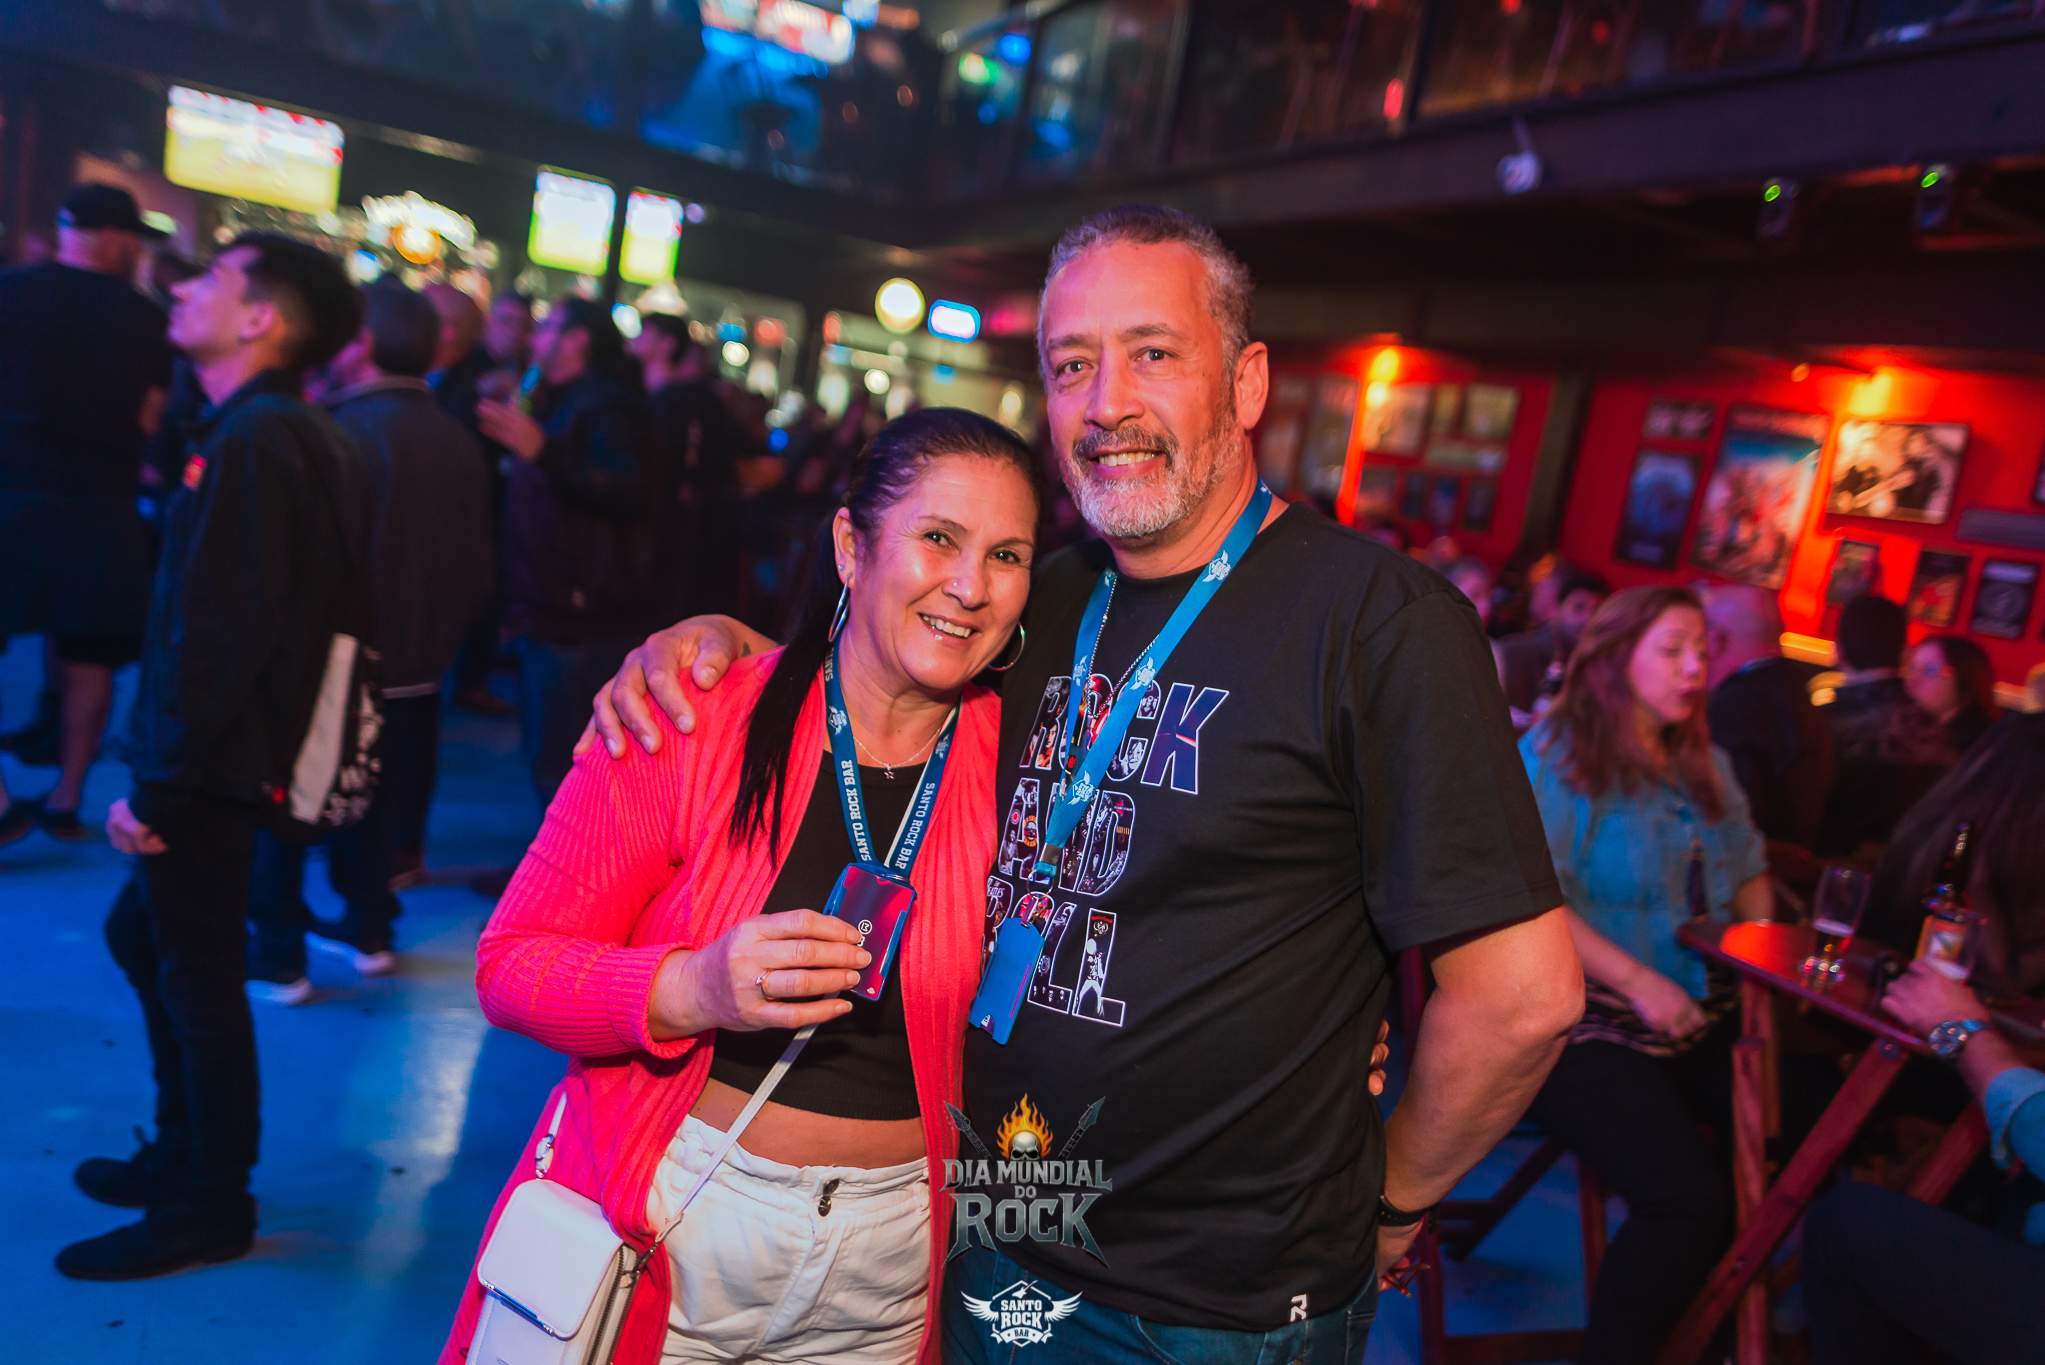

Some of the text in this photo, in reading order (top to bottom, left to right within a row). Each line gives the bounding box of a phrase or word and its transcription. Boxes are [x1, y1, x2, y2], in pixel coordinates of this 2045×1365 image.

[840, 759, 873, 862] SANTO ROCK BAR
[894, 782, 936, 870] SANTO ROCK BAR
